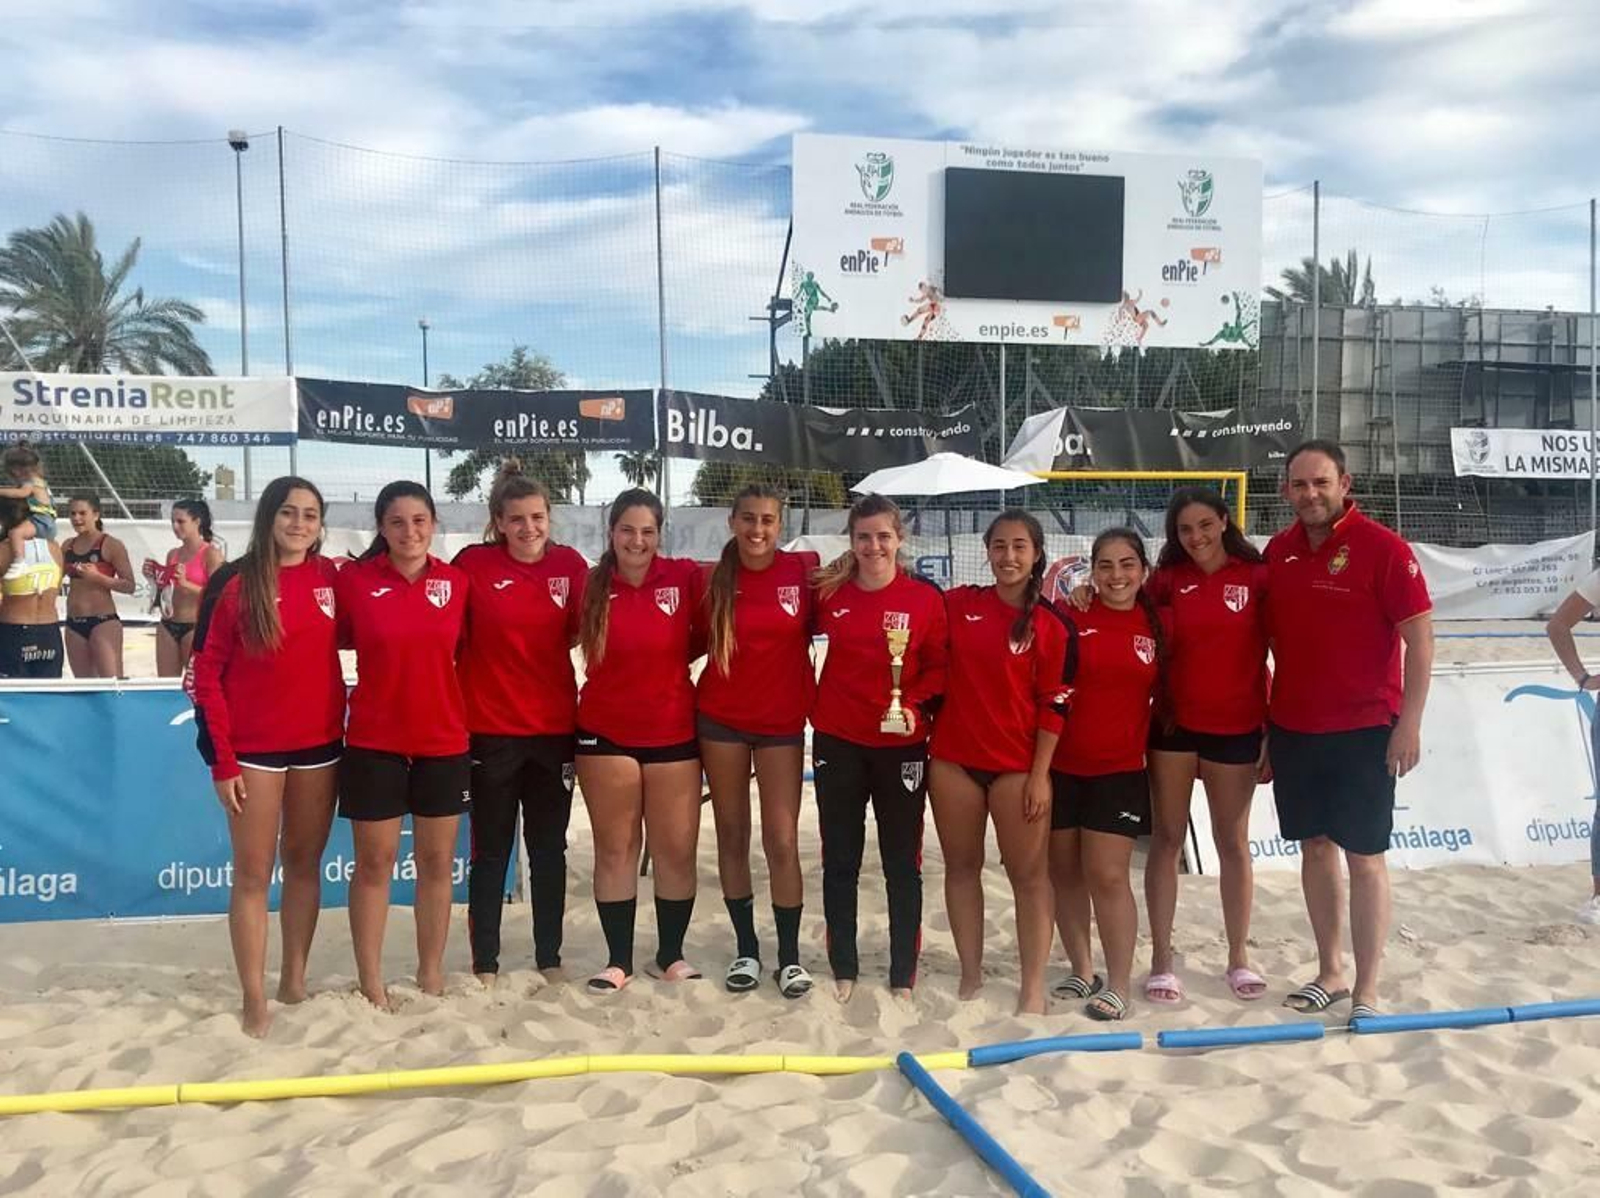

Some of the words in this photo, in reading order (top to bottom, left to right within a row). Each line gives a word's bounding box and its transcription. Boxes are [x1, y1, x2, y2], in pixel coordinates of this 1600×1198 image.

[986, 160, 1014, 168] como
[1017, 160, 1046, 169] todos
[1045, 151, 1056, 159] es
[1060, 152, 1076, 160] tan
[1079, 153, 1110, 162] bueno
[840, 249, 879, 273] enPie
[1162, 259, 1198, 281] enPie
[979, 322, 1048, 340] enpie.es
[13, 379, 235, 408] StreniaRent
[13, 413, 122, 425] MAQUINARIA
[132, 415, 150, 425] DE
[160, 415, 236, 426] LIMPIEZA
[317, 405, 405, 433] enPie.es
[494, 413, 578, 437] enPie.es
[1212, 419, 1292, 438] construyendo
[175, 433, 204, 443] 747
[211, 433, 238, 443] 860
[243, 434, 270, 443] 346
[667, 409, 763, 451] Bilba.
[889, 421, 971, 440] construyendo
[1542, 434, 1579, 452] NOS
[1505, 455, 1526, 472] LA
[1531, 456, 1591, 473] MISMA
